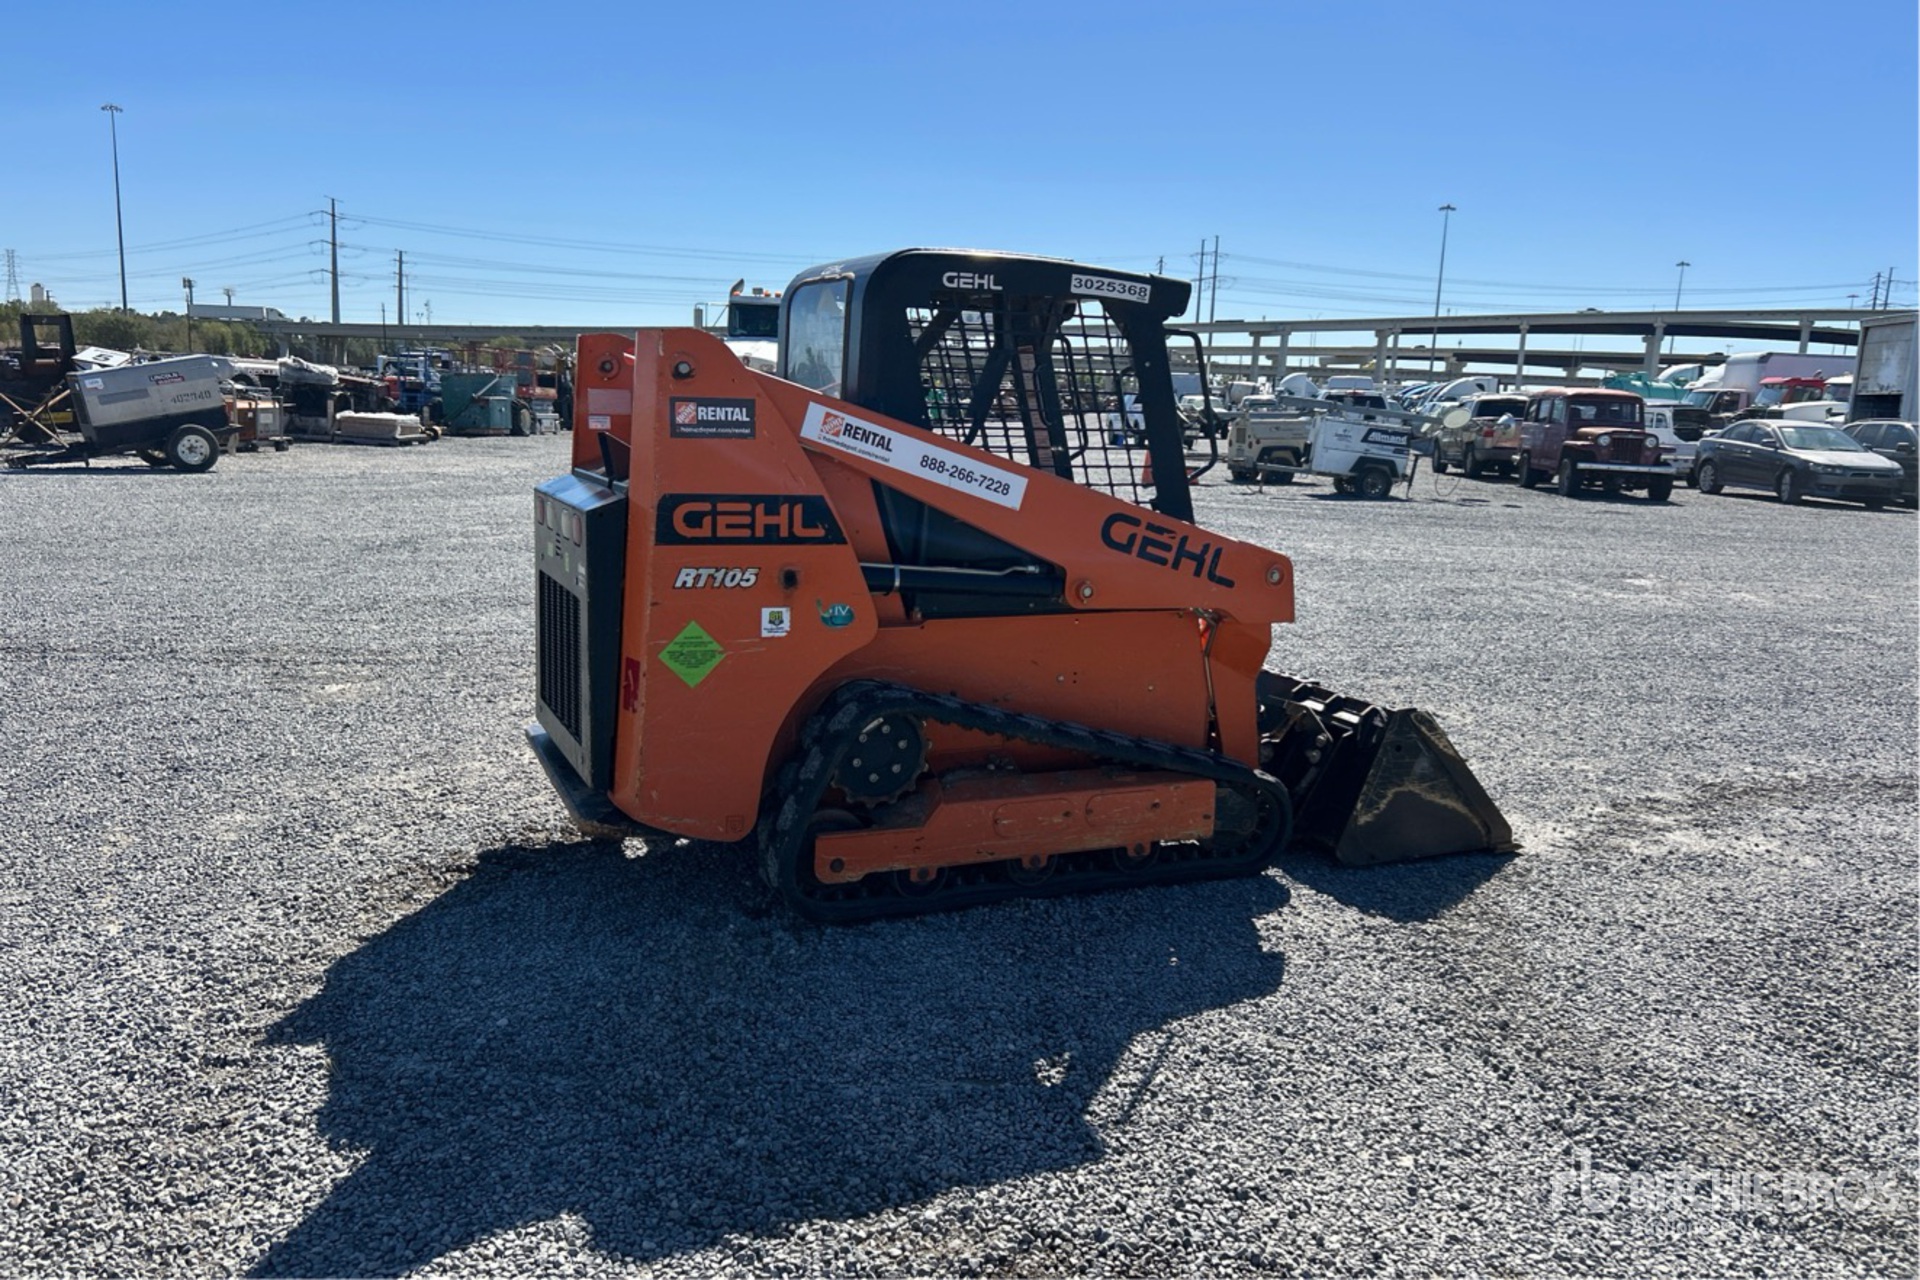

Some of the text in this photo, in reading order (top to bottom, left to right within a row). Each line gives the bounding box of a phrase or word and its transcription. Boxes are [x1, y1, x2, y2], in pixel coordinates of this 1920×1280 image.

[942, 271, 1003, 290] GEHL
[1073, 277, 1148, 297] 3025368
[698, 407, 750, 421] RENTAL
[843, 422, 893, 452] RENTAL
[920, 455, 1010, 496] 888-266-7228
[673, 502, 825, 538] GEHL
[1101, 512, 1235, 588] GEHL
[674, 567, 759, 588] RT105
